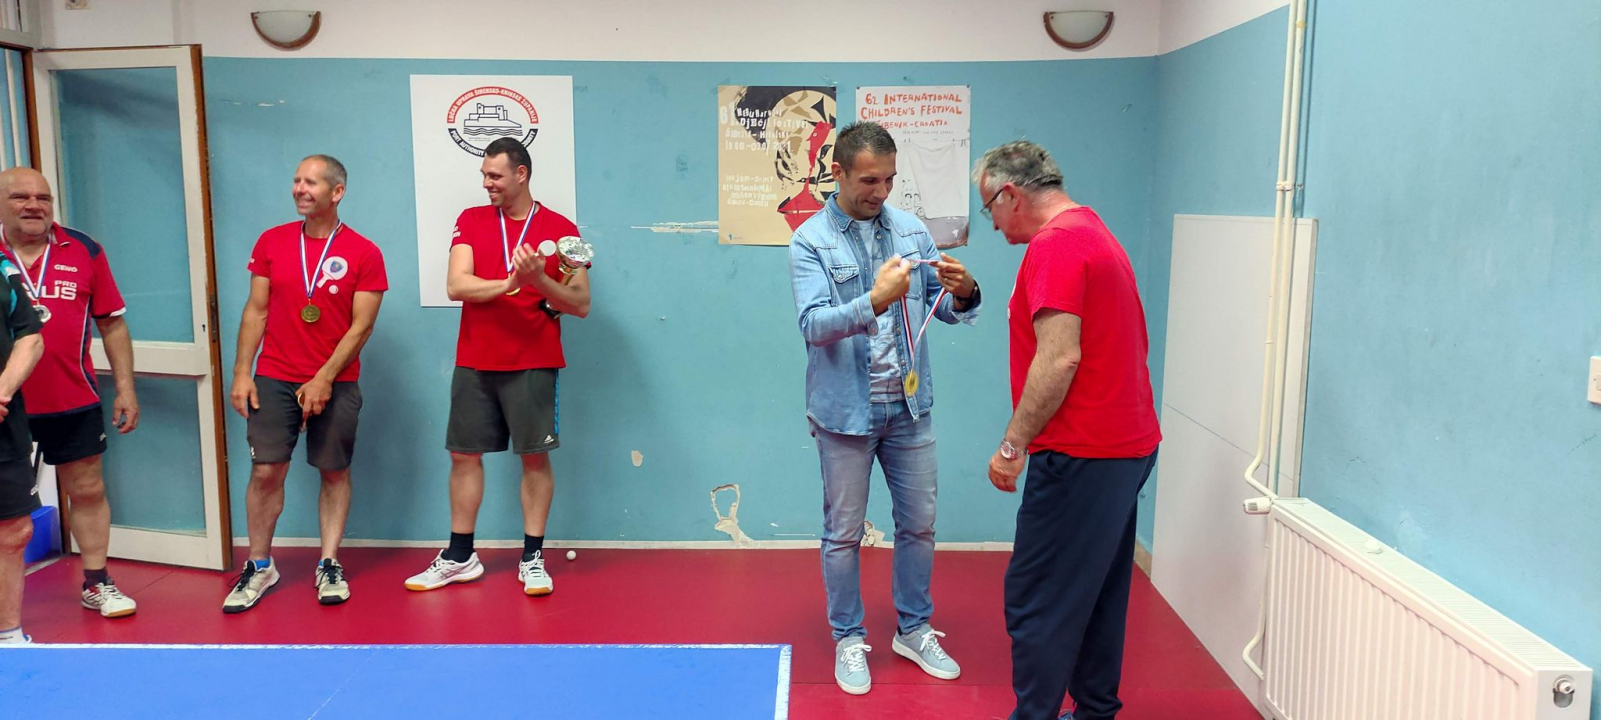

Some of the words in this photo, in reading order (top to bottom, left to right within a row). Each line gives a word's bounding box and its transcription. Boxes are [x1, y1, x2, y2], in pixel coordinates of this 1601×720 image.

[865, 93, 878, 105] 62
[883, 93, 962, 105] INTERNATIONAL
[860, 106, 915, 120] CHILDREN'S
[920, 105, 962, 116] FESTIVAL
[450, 130, 462, 144] PORT
[459, 140, 485, 157] AUTHORITY
[54, 280, 77, 288] PRO
